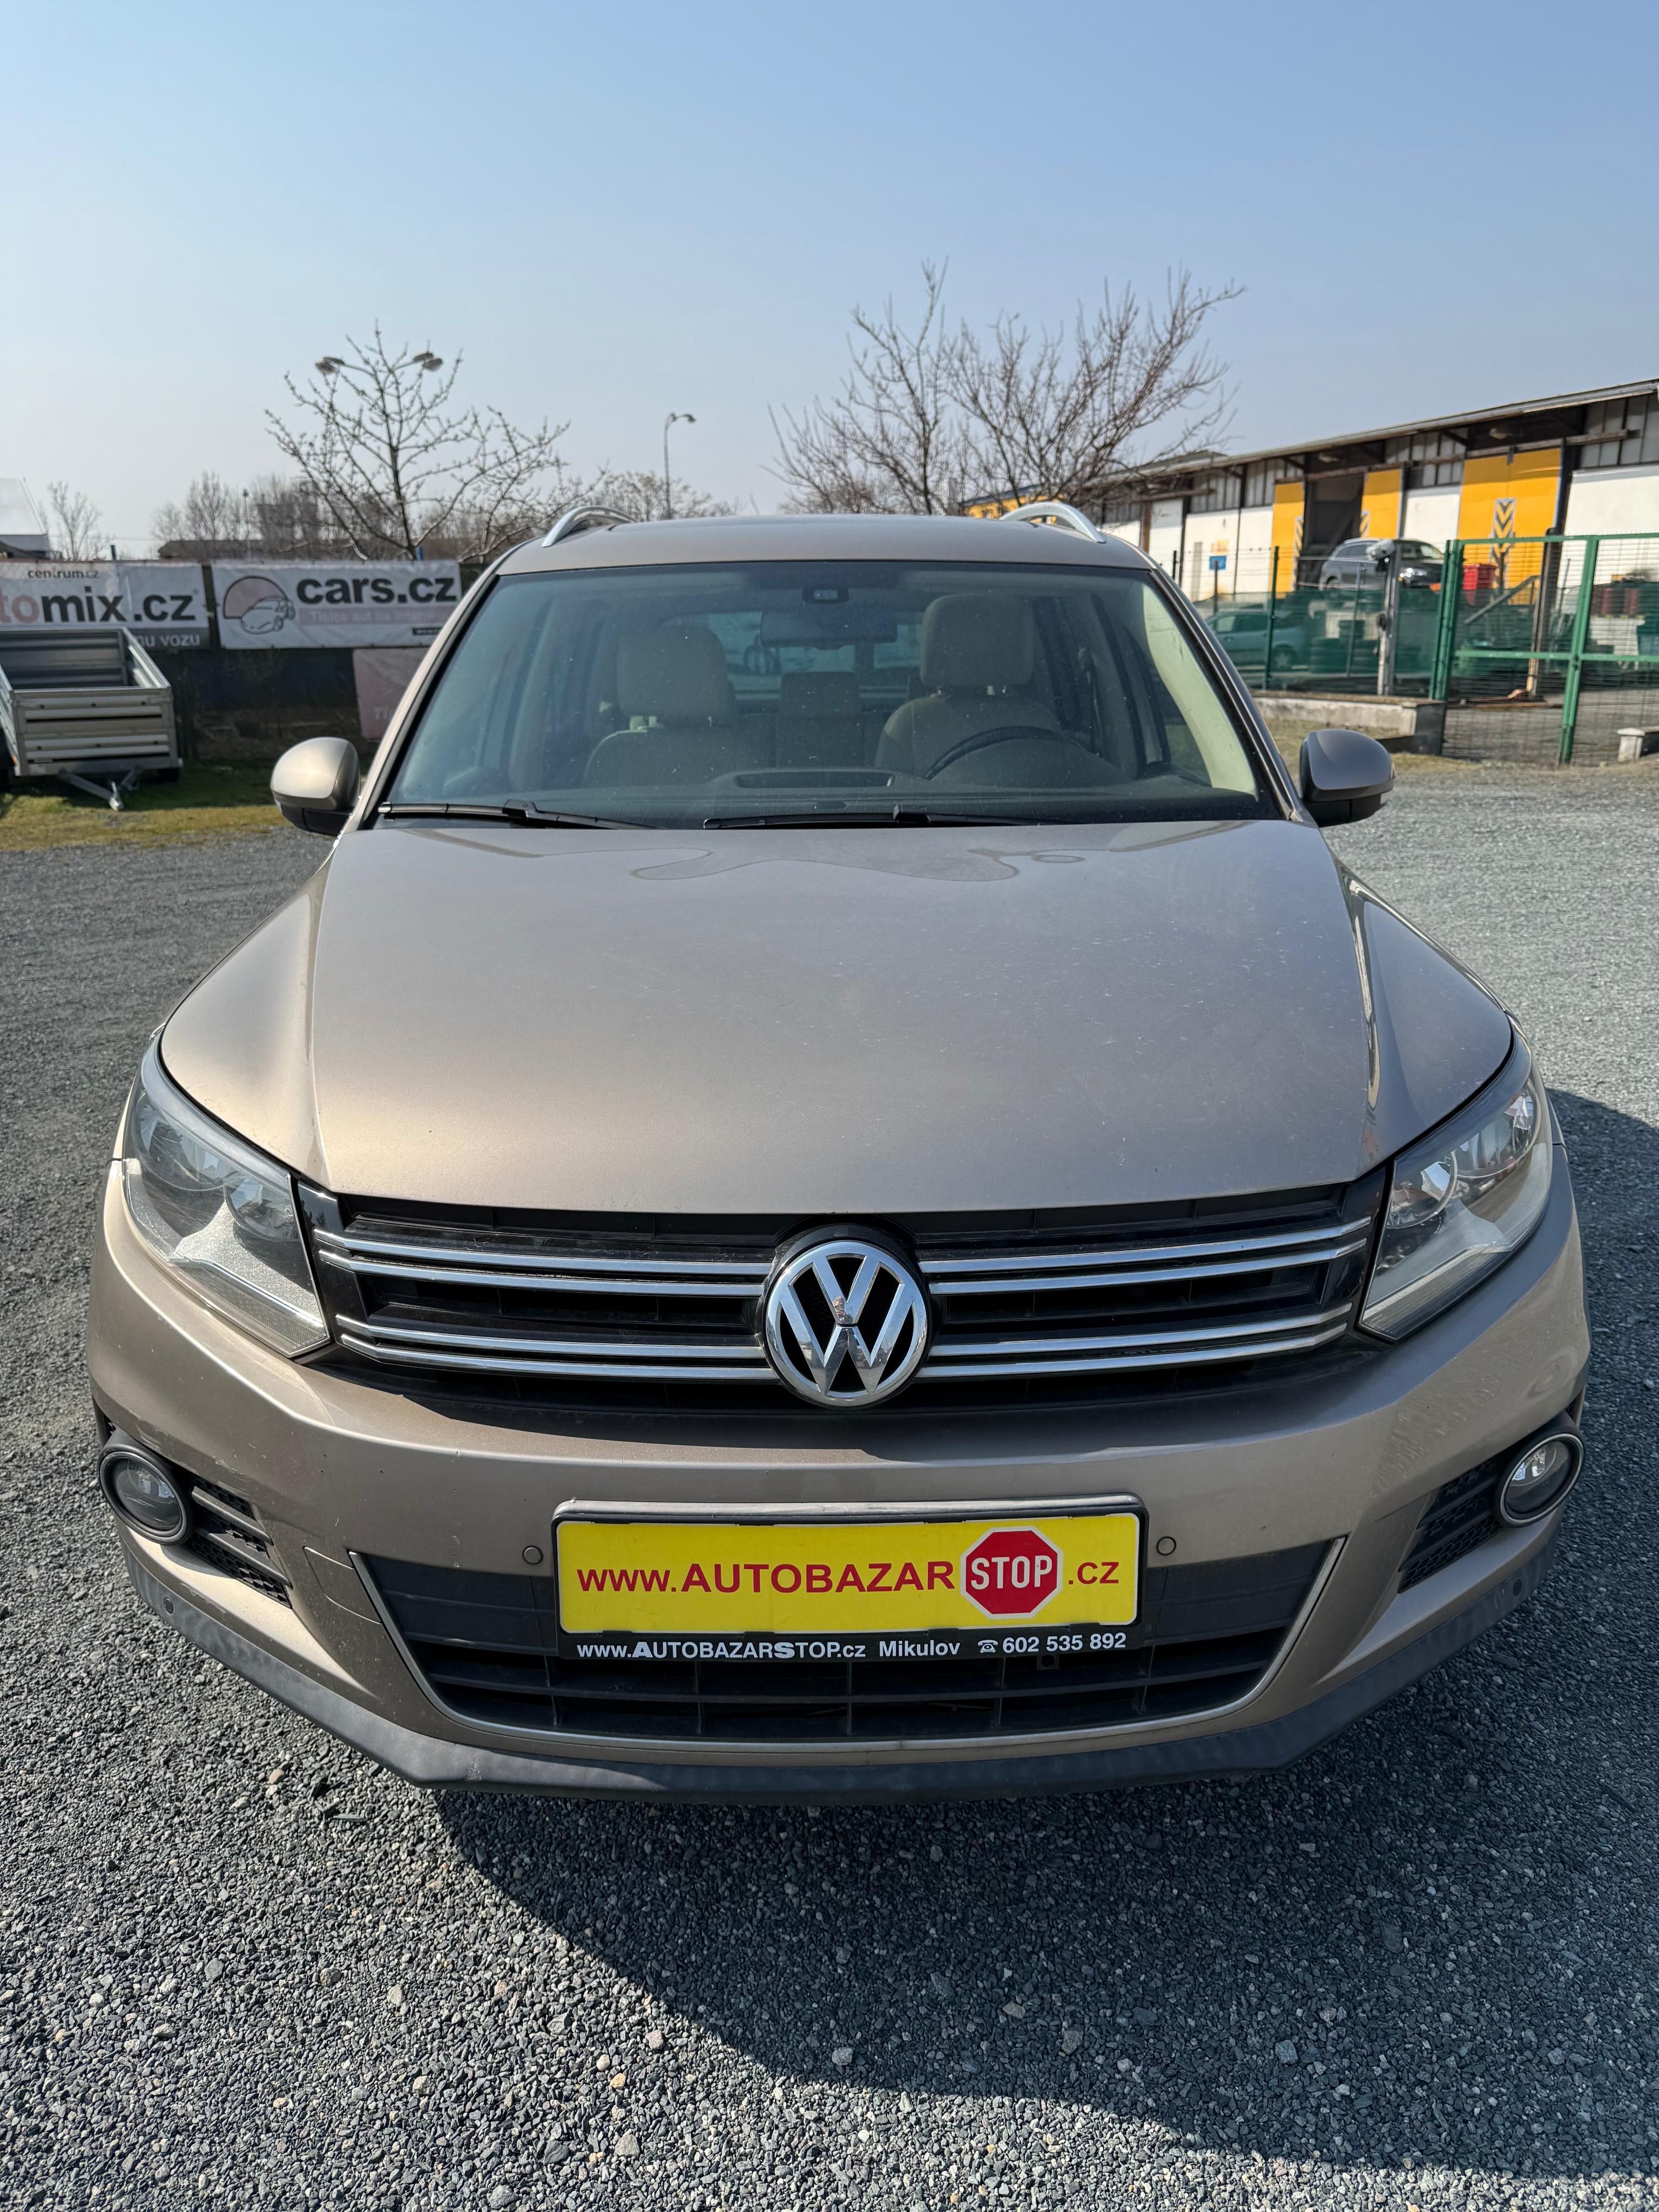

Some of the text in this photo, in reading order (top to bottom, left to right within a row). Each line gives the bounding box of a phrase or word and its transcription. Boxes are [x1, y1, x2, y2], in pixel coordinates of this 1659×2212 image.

[28, 566, 99, 579] centrum.cz
[296, 577, 458, 604] cars.cz
[159, 633, 200, 647] vozu
[879, 1639, 961, 1657] Mikulov
[1002, 1637, 1039, 1654] 602
[1046, 1635, 1083, 1651] 535
[1089, 1632, 1127, 1650] 892
